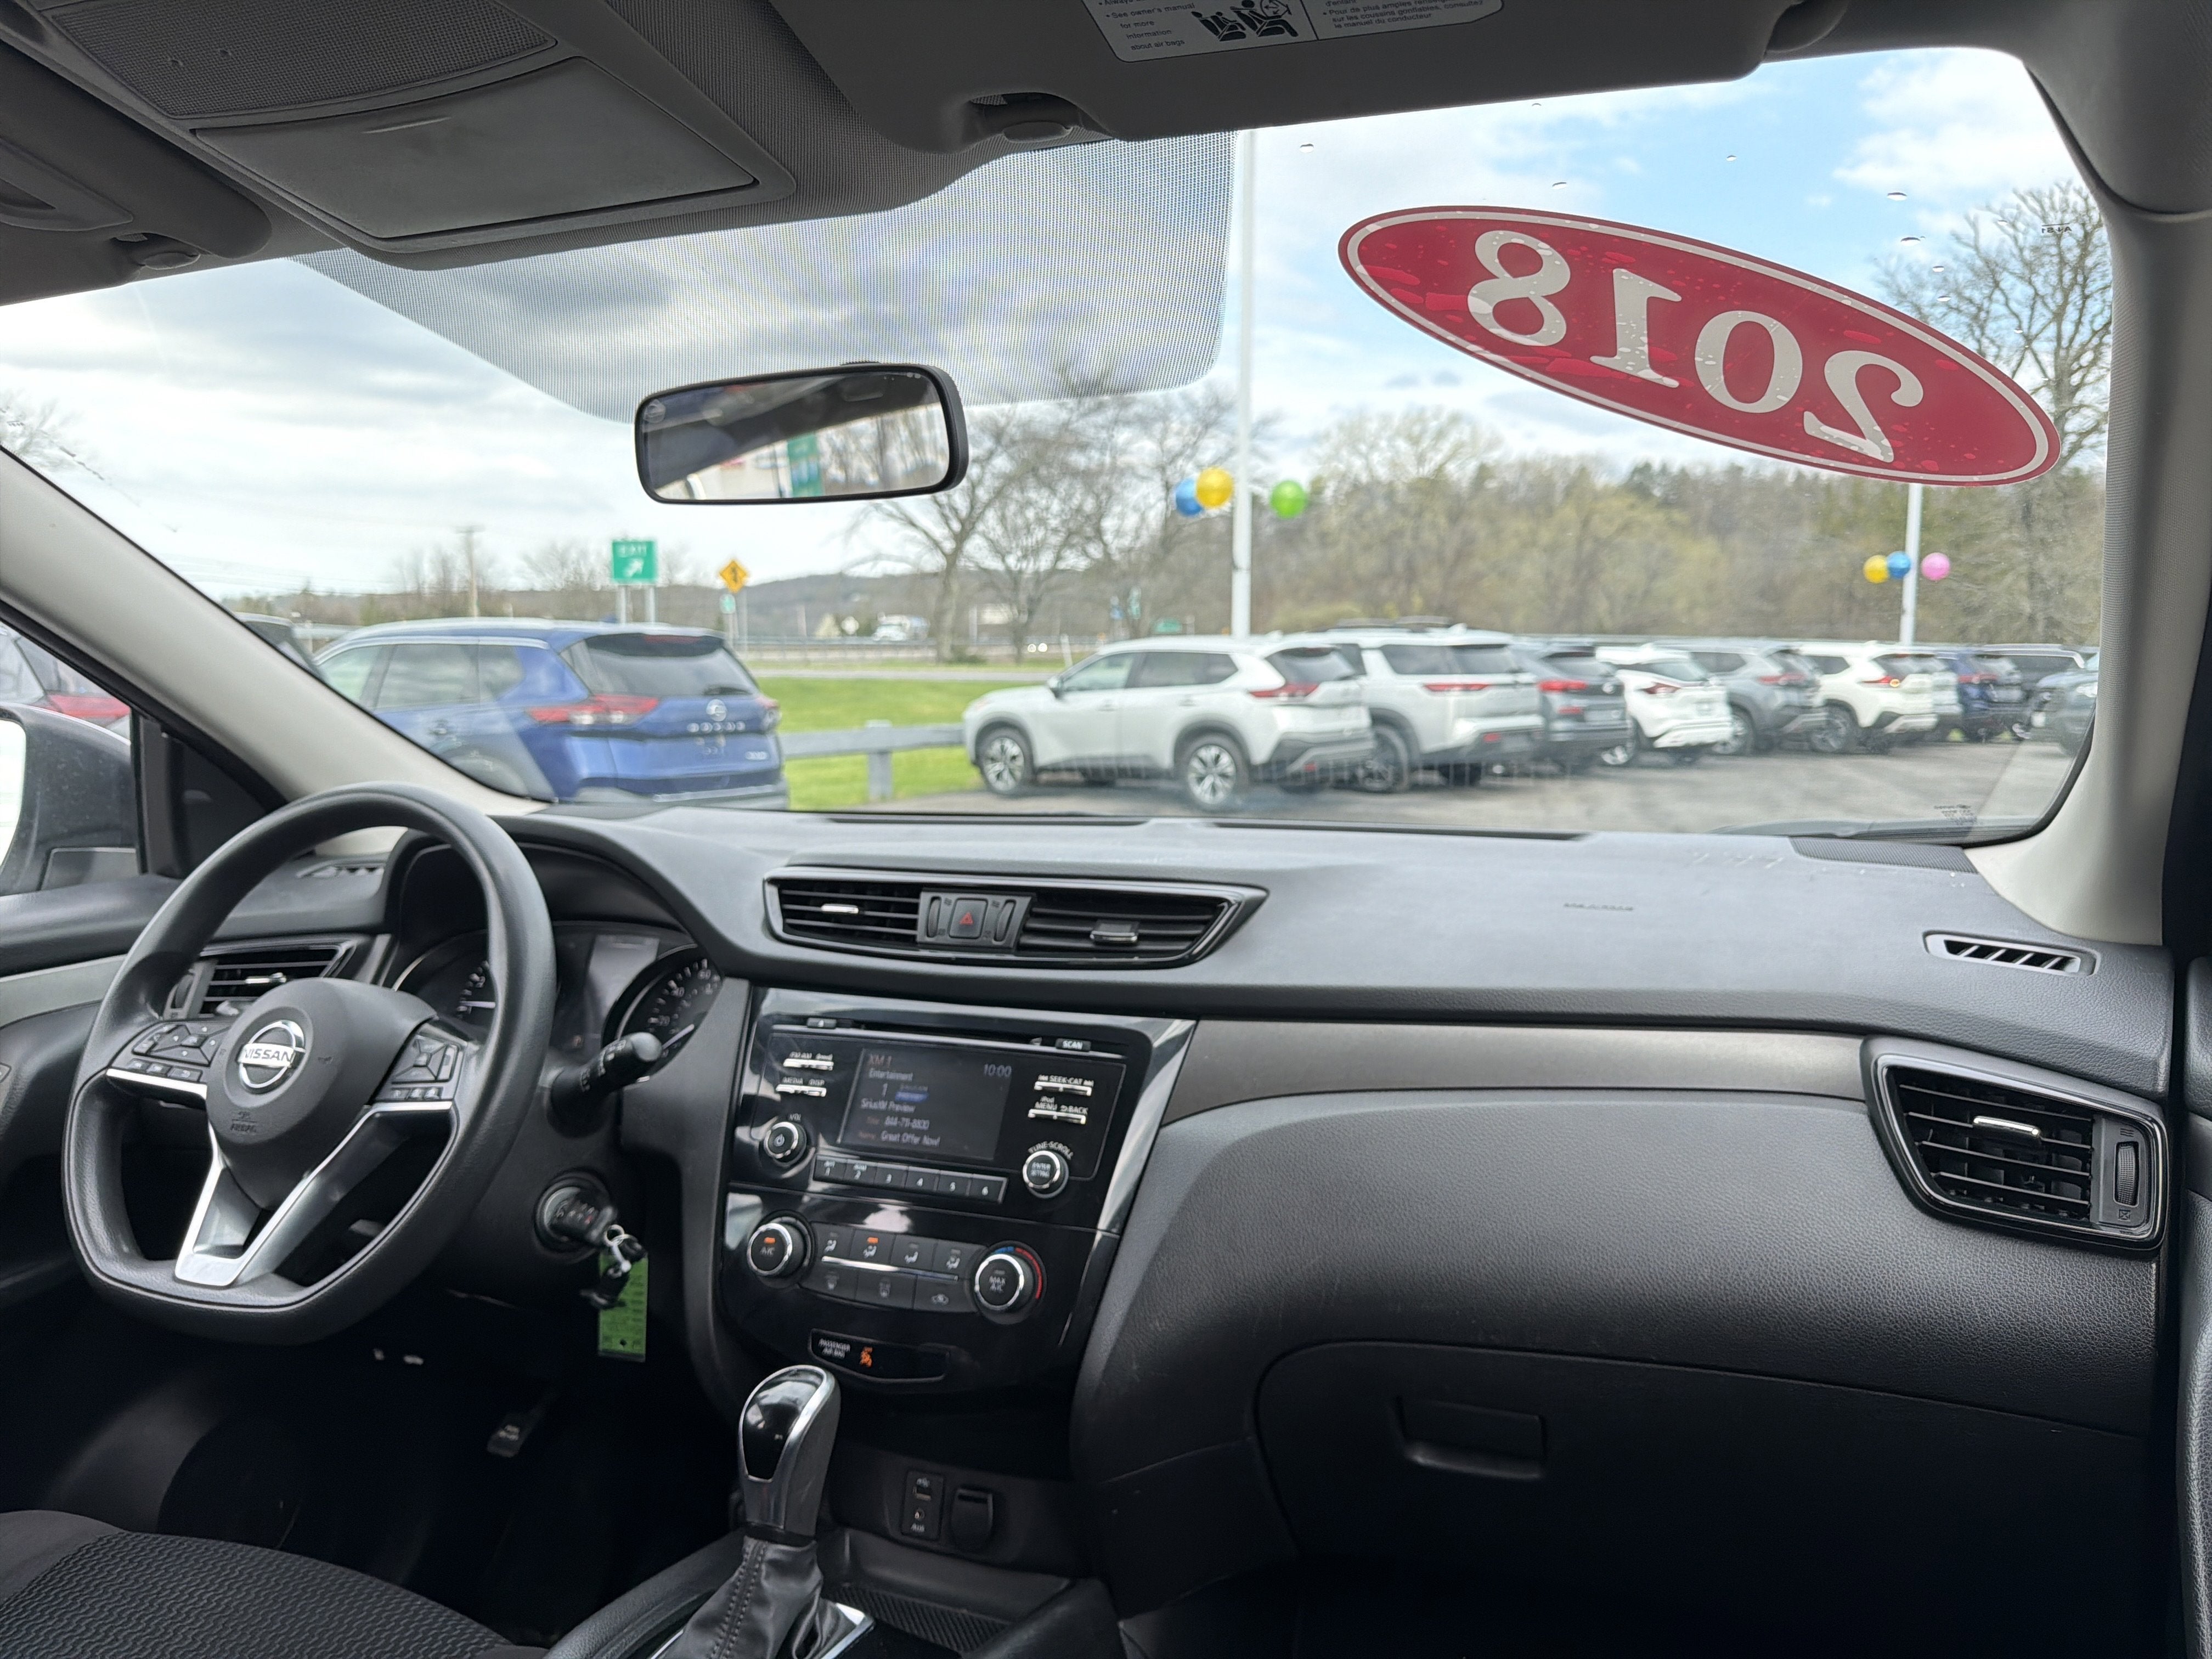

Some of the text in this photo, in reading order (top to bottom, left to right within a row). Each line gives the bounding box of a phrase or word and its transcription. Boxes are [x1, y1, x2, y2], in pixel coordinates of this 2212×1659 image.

[1131, 8, 1162, 16] owner's
[1165, 3, 1195, 12] manual
[1361, 10, 1396, 19] coussins
[1387, 13, 1432, 22] conducteur
[1126, 29, 1172, 40] information
[1131, 42, 1152, 50] about
[1062, 1040, 1083, 1050] SCAN
[244, 1048, 295, 1062] NISSAN
[868, 1068, 913, 1081] Entertainment
[984, 1064, 1012, 1077] 10:00
